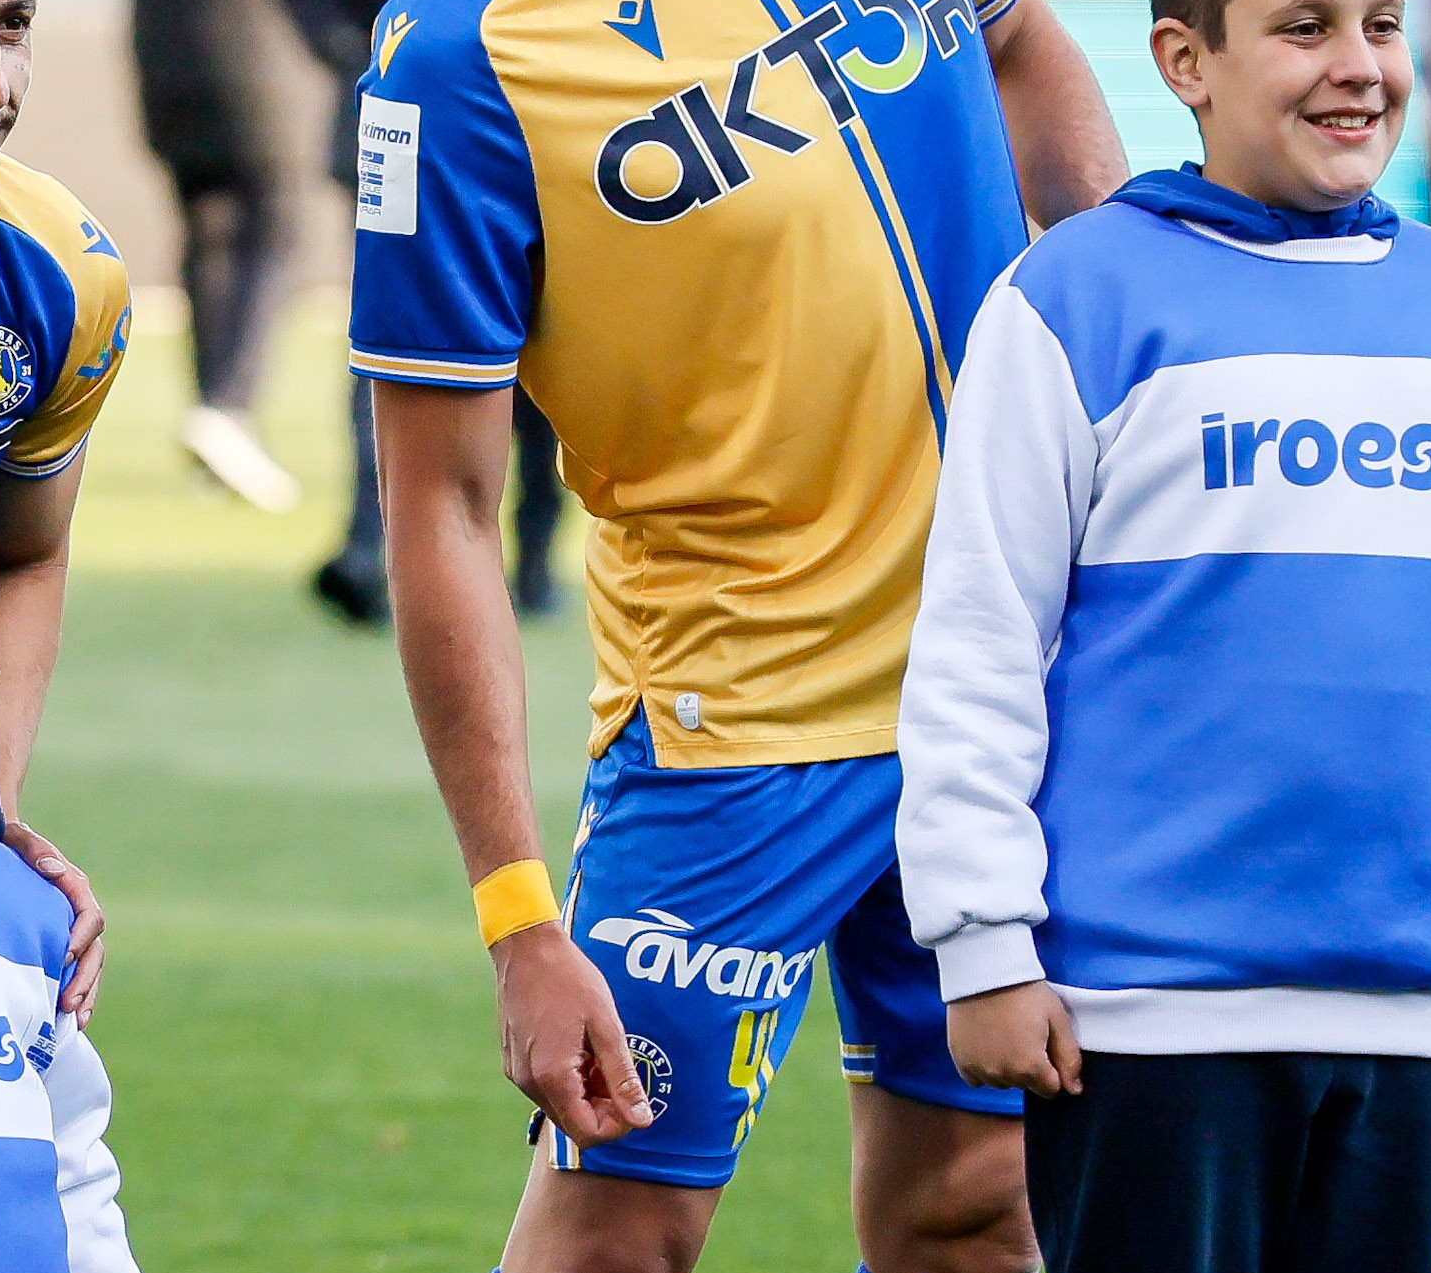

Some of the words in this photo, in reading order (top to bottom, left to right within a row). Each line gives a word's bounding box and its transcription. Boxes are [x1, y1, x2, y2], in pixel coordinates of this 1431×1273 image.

[21, 365, 32, 376] 31
[629, 1037, 665, 1067] ERAS
[658, 1082, 672, 1094] 31
